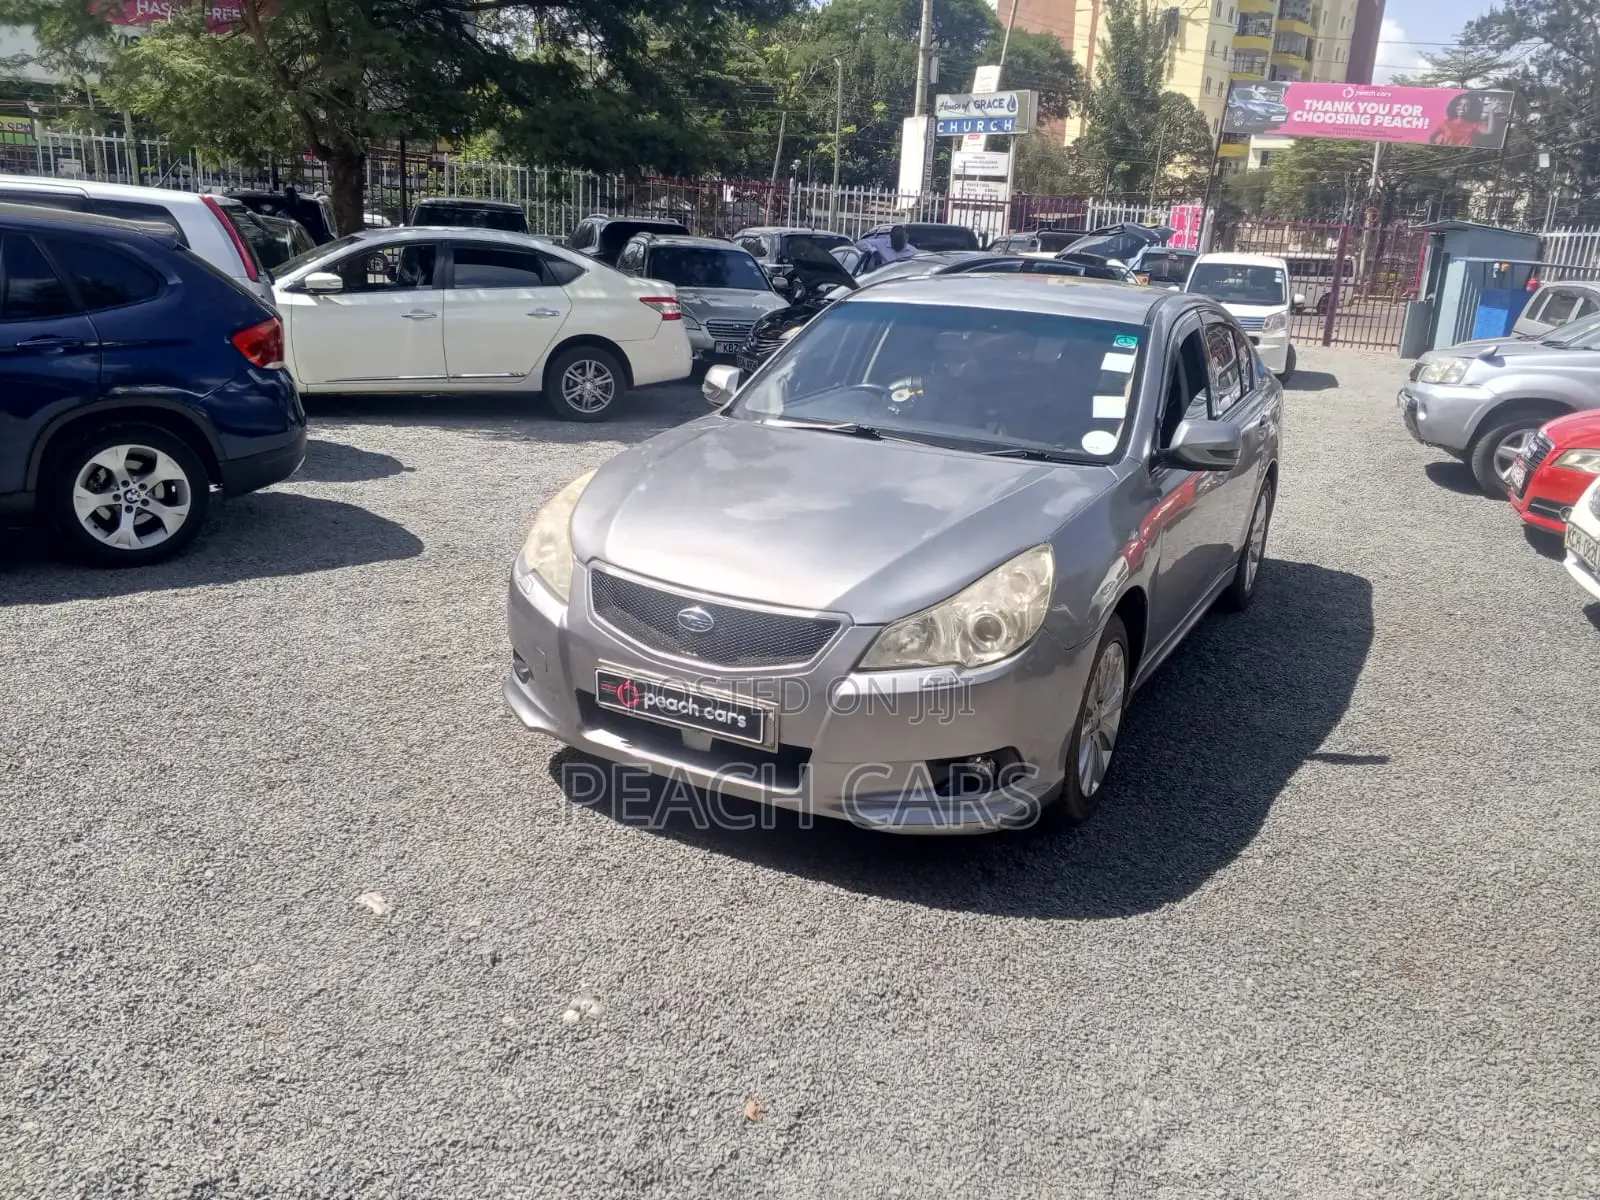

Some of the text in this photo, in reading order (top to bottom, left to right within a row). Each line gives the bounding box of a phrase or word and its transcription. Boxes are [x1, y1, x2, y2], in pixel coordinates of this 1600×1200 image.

[938, 100, 961, 112] House
[973, 98, 1005, 110] GRACE
[1303, 99, 1424, 117] THANK YOU FOR
[937, 120, 1012, 132] CHURCH
[1292, 110, 1430, 130] CHOOSING PEACH!
[643, 692, 747, 729] peach cars
